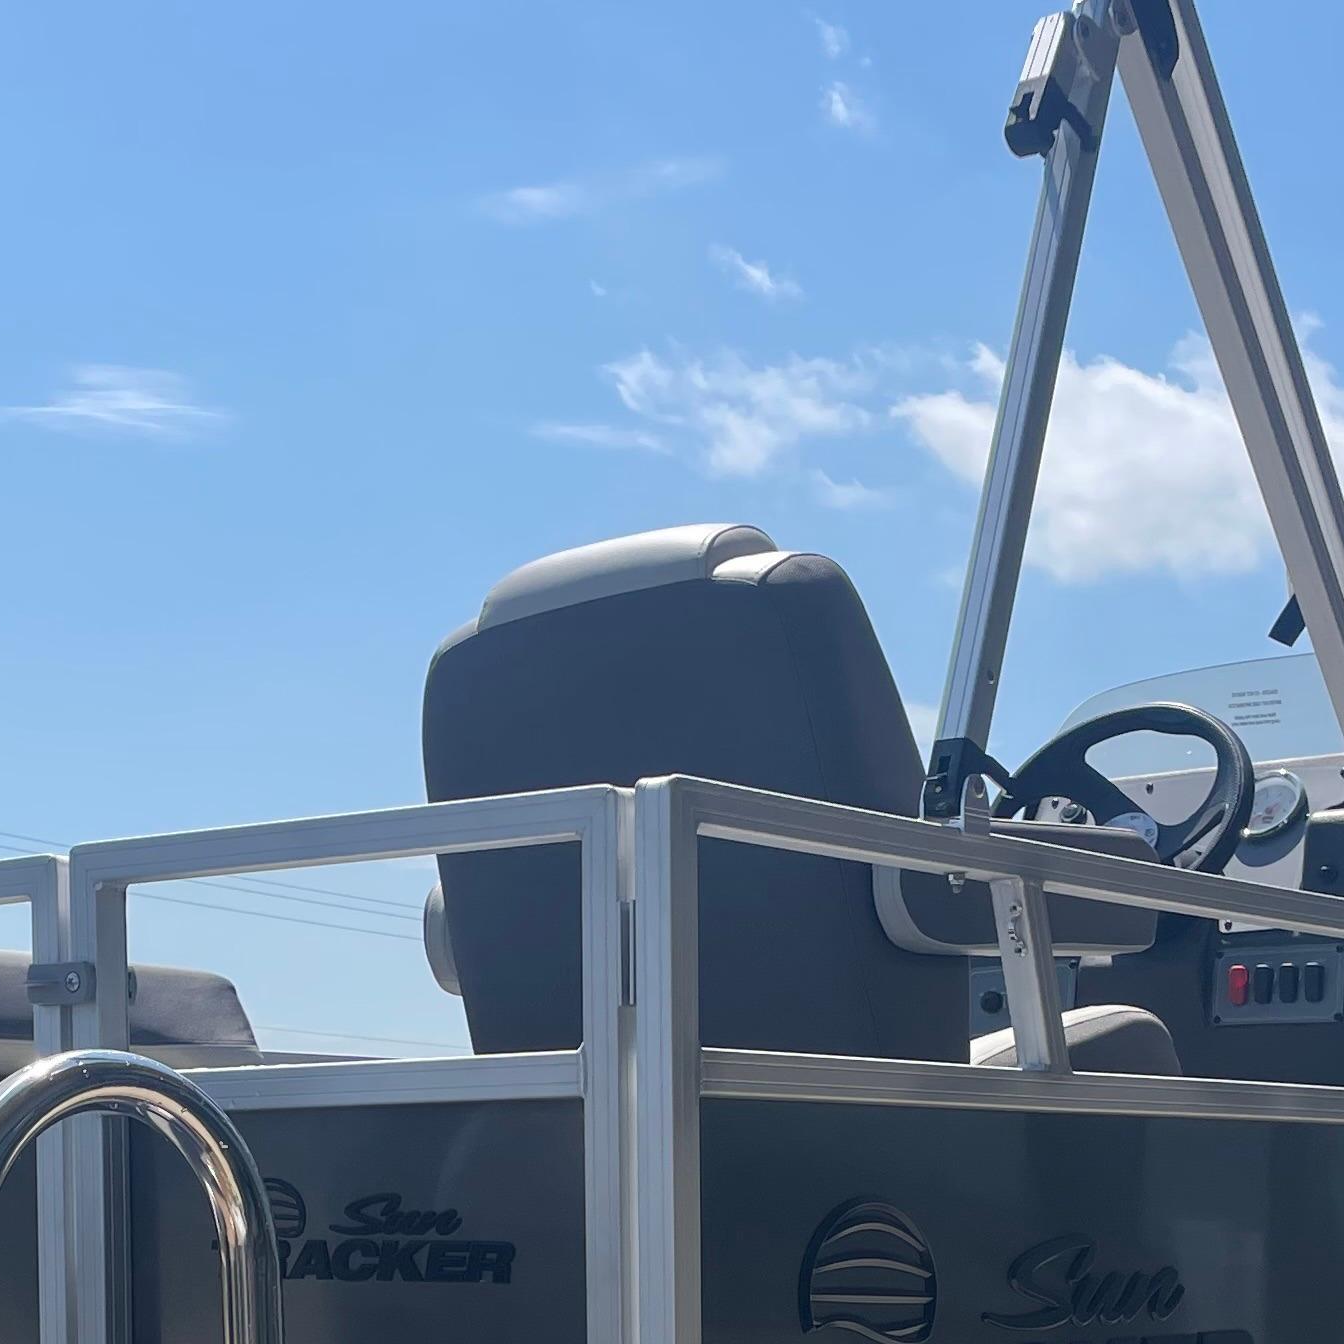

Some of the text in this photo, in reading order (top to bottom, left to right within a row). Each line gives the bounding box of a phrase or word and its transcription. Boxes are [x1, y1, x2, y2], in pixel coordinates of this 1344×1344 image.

[329, 1193, 462, 1236] Sun
[212, 1239, 516, 1284] ACKER
[981, 1232, 1186, 1331] Sun
